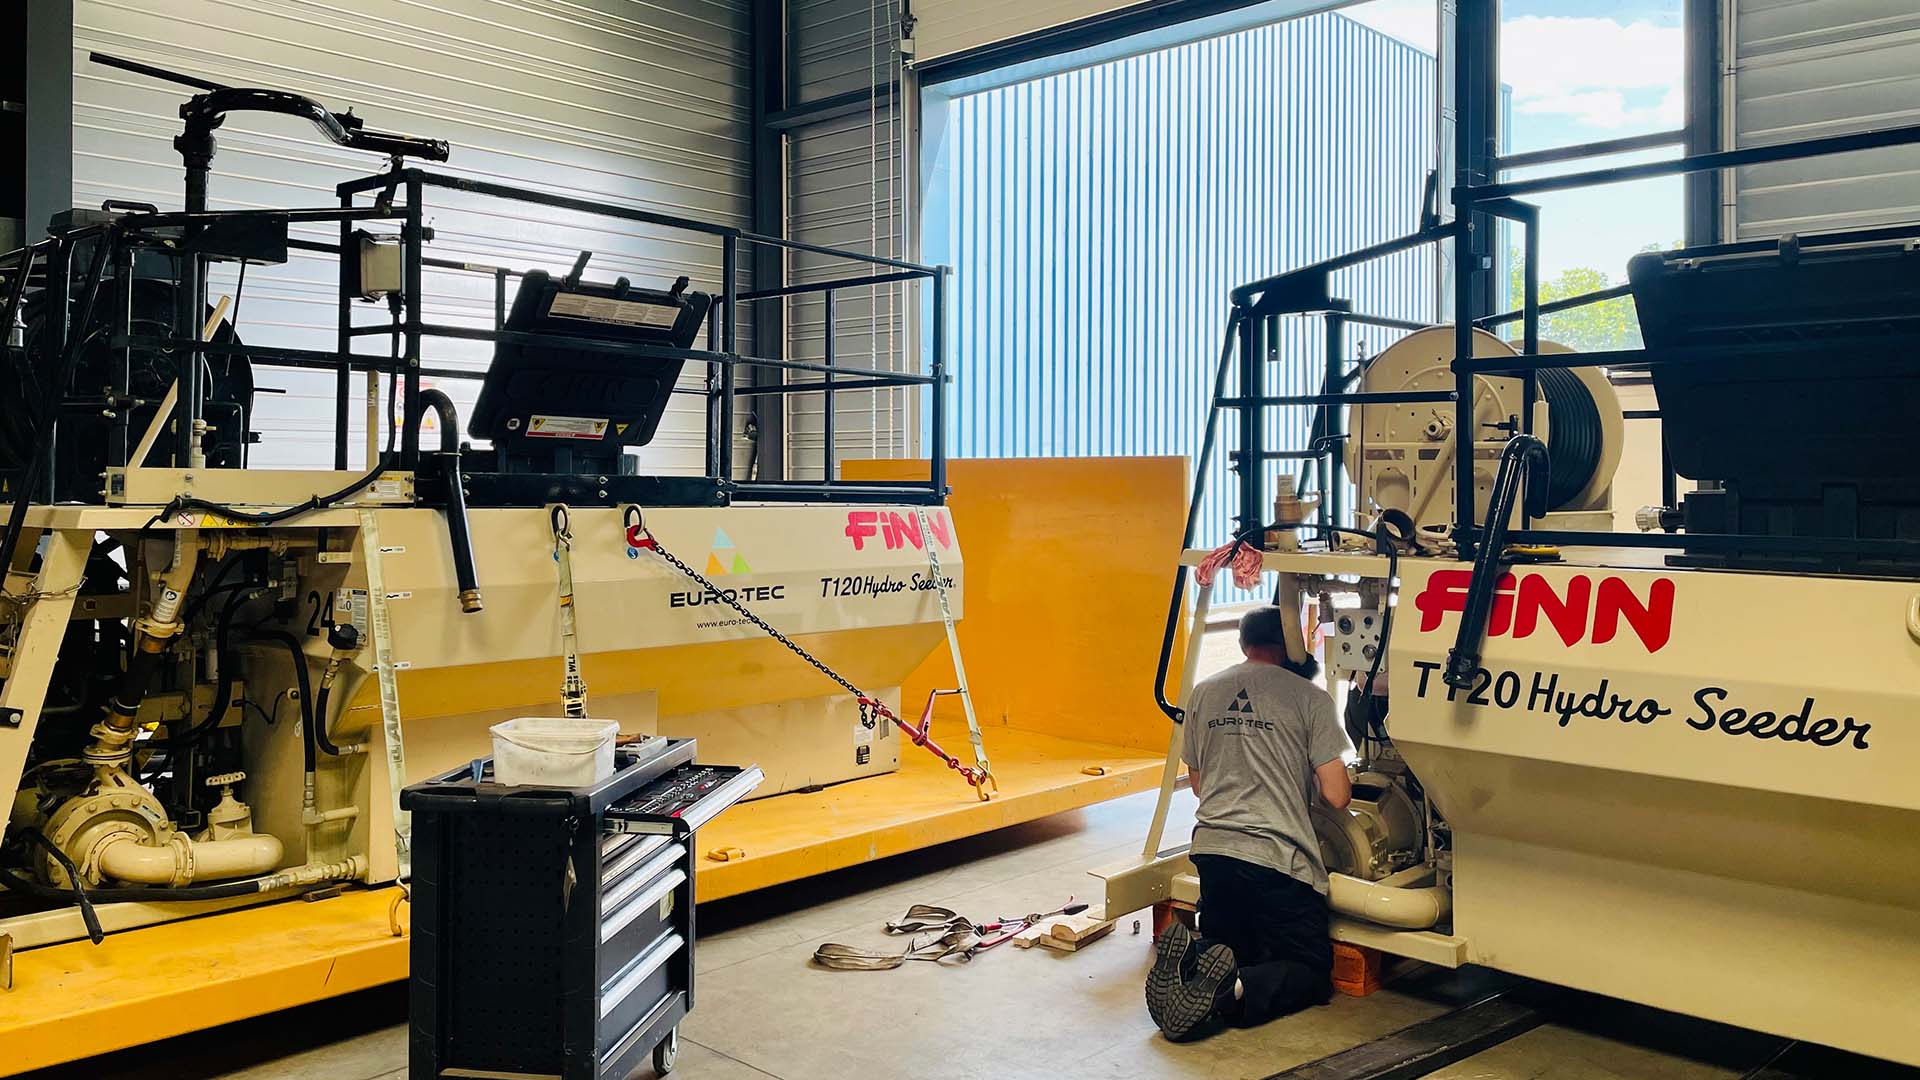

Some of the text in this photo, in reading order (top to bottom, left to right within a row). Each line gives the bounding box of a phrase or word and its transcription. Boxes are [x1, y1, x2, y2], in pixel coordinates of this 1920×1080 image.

[670, 585, 784, 608] EURO-TEC
[820, 573, 952, 598] T120 Hydro Seer
[306, 590, 335, 637] 24
[696, 618, 752, 628] www.euro-tec
[568, 654, 576, 673] WLL
[1527, 671, 1672, 727] Hydro
[1686, 687, 1871, 750] Seeder
[1207, 717, 1274, 731] EURO-TEC
